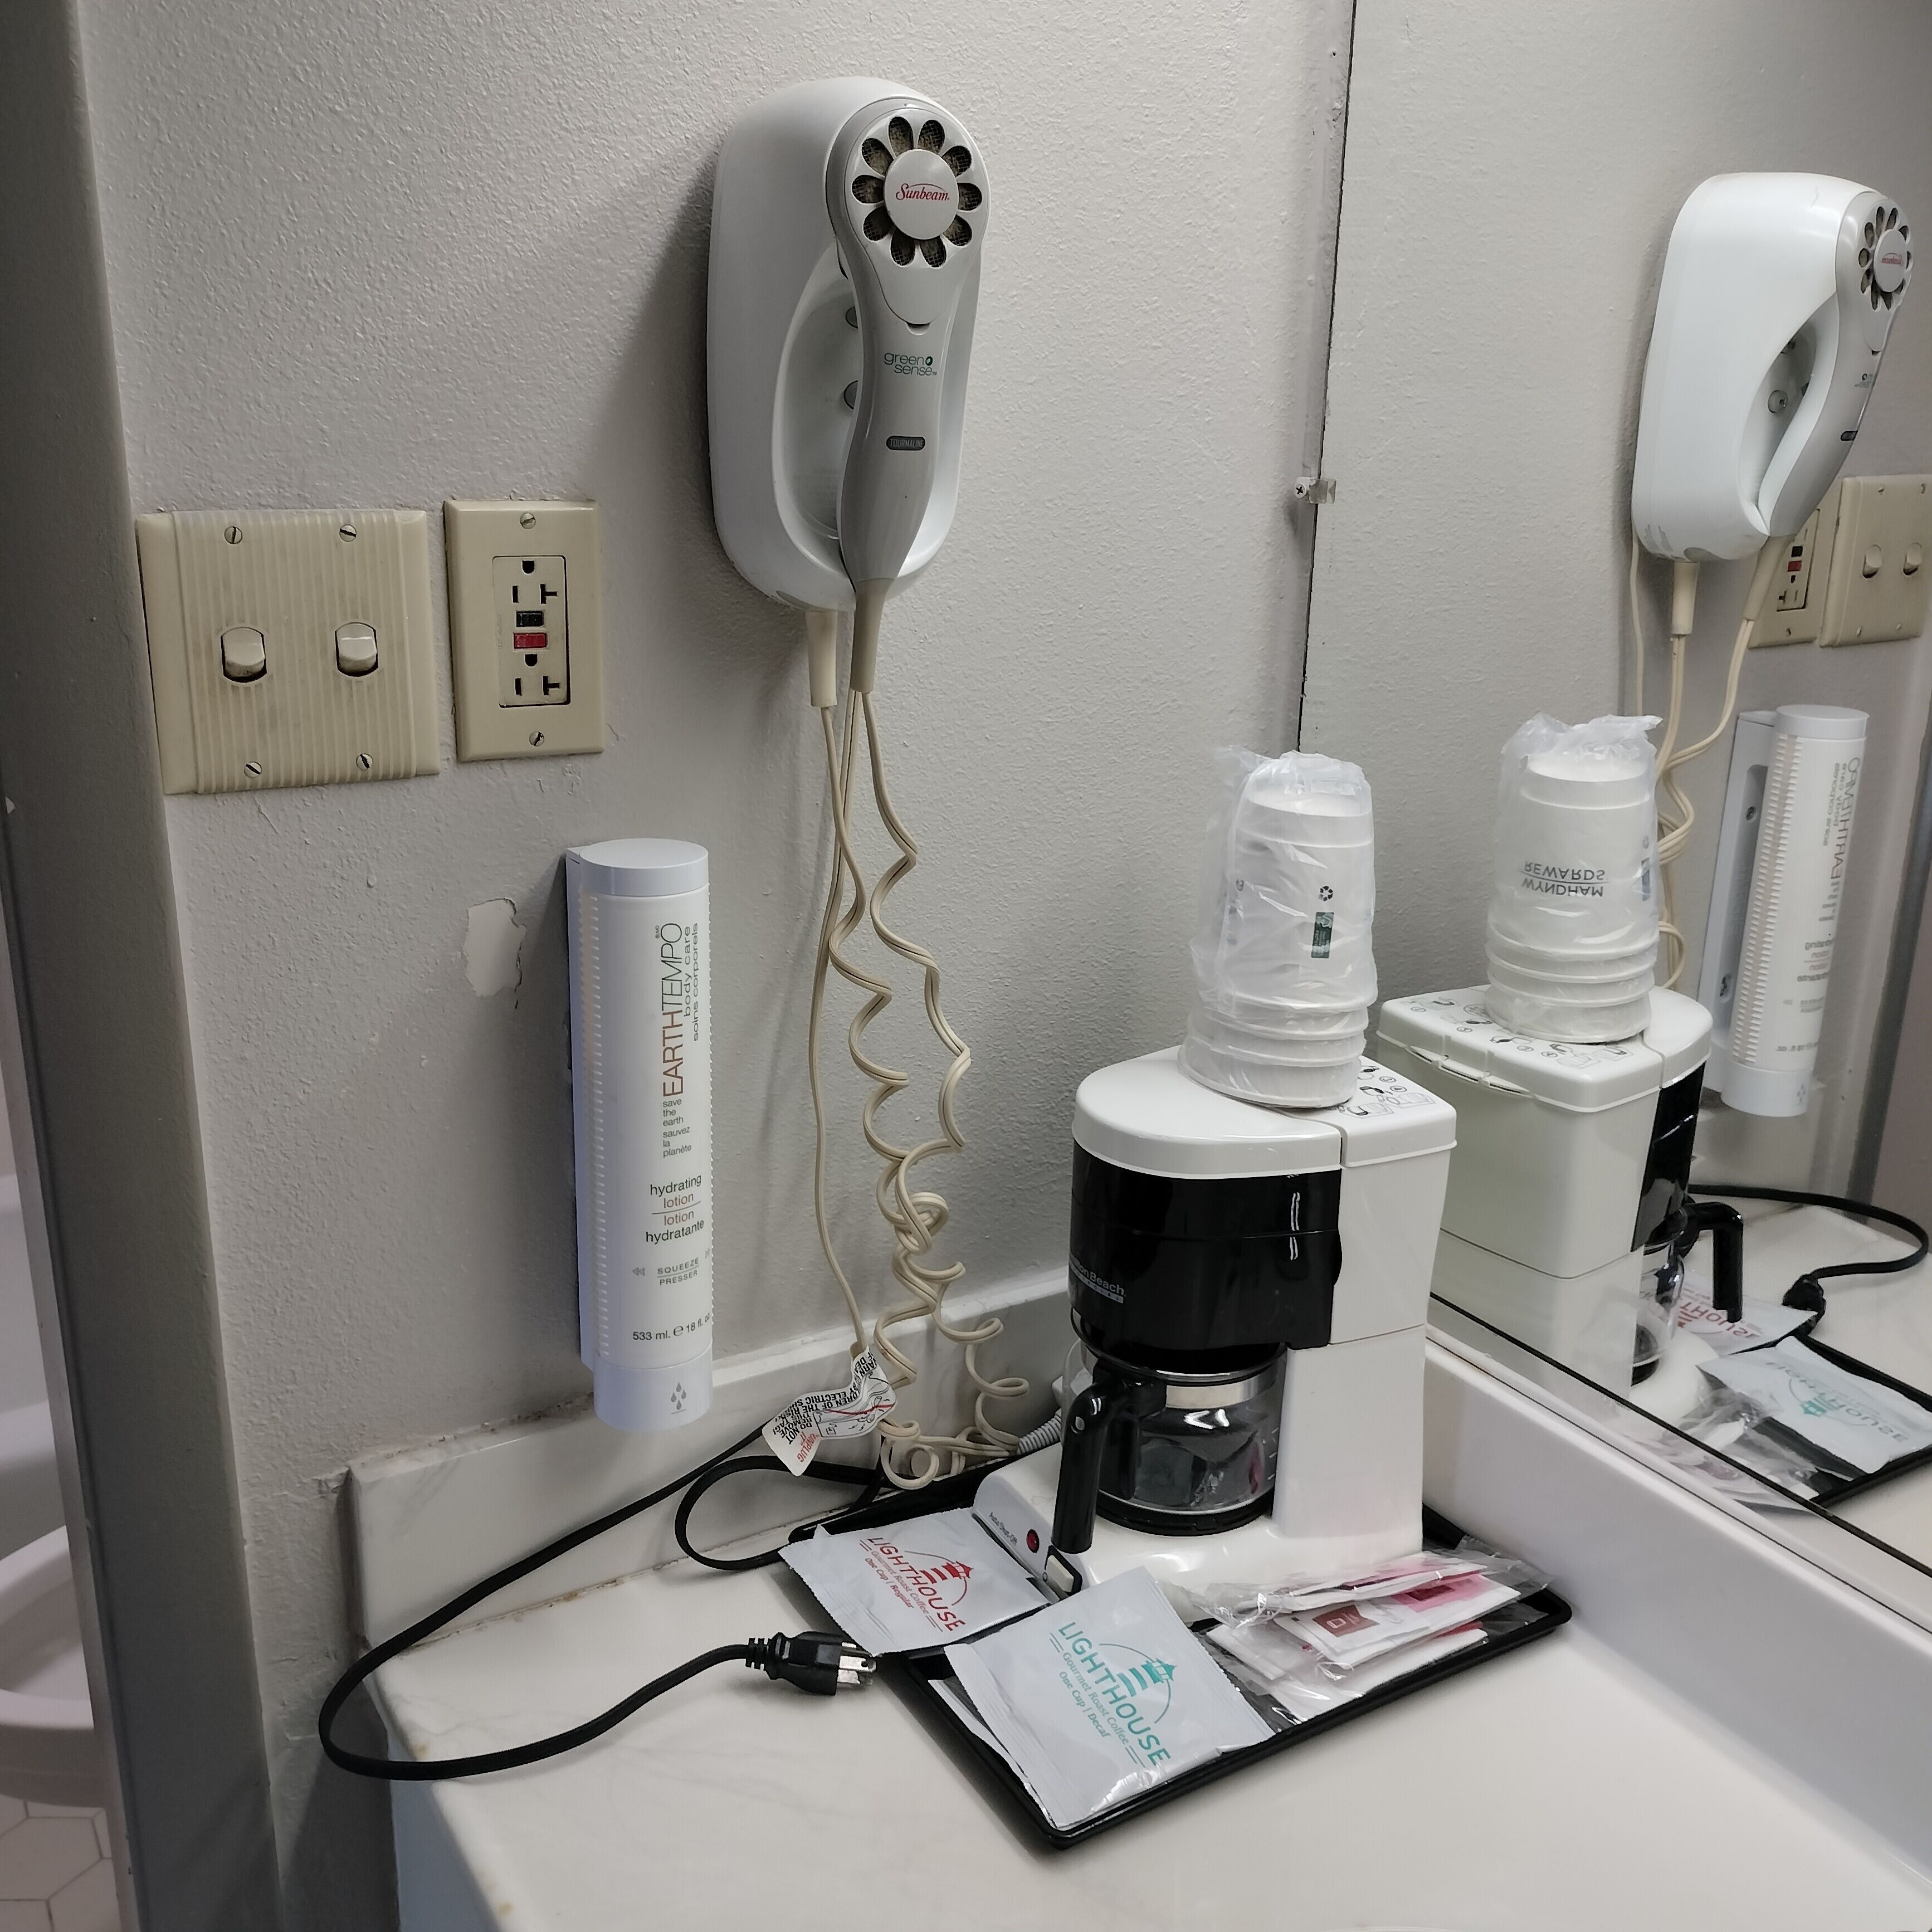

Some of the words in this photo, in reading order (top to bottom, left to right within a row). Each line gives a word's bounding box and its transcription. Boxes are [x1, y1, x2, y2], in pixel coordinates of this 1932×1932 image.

[895, 183, 948, 202] Sunbeam
[884, 352, 925, 366] green
[684, 973, 692, 1017] body
[660, 923, 683, 1097] EARTHTEMPO
[662, 1097, 682, 1108] save
[662, 1108, 677, 1116] the
[662, 1115, 684, 1126] earth
[662, 1125, 691, 1139] sauvez
[662, 1139, 671, 1148] la
[662, 1144, 692, 1158] planète
[650, 1174, 702, 1198] hydrating
[663, 1192, 694, 1209] lotion
[663, 1210, 695, 1226] lotion
[645, 1220, 705, 1245] hydratante
[657, 1257, 700, 1275] SQUEEZE
[659, 1270, 699, 1286] PRESSER
[633, 1331, 652, 1340] 533
[655, 1330, 671, 1339] ml.
[686, 1322, 696, 1333] 18
[807, 1391, 847, 1405] ELECTRIC
[802, 1404, 818, 1413] THE
[773, 1417, 790, 1435] TAG!
[780, 1417, 812, 1438] REMOVE
[785, 1427, 800, 1445] NOT
[865, 1557, 877, 1571] One
[875, 1568, 888, 1585] Cup
[891, 1584, 914, 1609] Regular
[867, 1537, 966, 1631] LIGHTHOUSE
[871, 1550, 896, 1576] Gourmet
[892, 1574, 913, 1594] Roast
[910, 1591, 929, 1616] Coffee
[1058, 1621, 1172, 1766] LIGHTHOUSE
[1062, 1651, 1092, 1693] Gourmet
[1087, 1690, 1110, 1718] Roast
[1106, 1715, 1129, 1745] Coffee
[1058, 1671, 1074, 1692] One
[1071, 1687, 1086, 1711] Cup
[1087, 1712, 1111, 1740] Decaf
